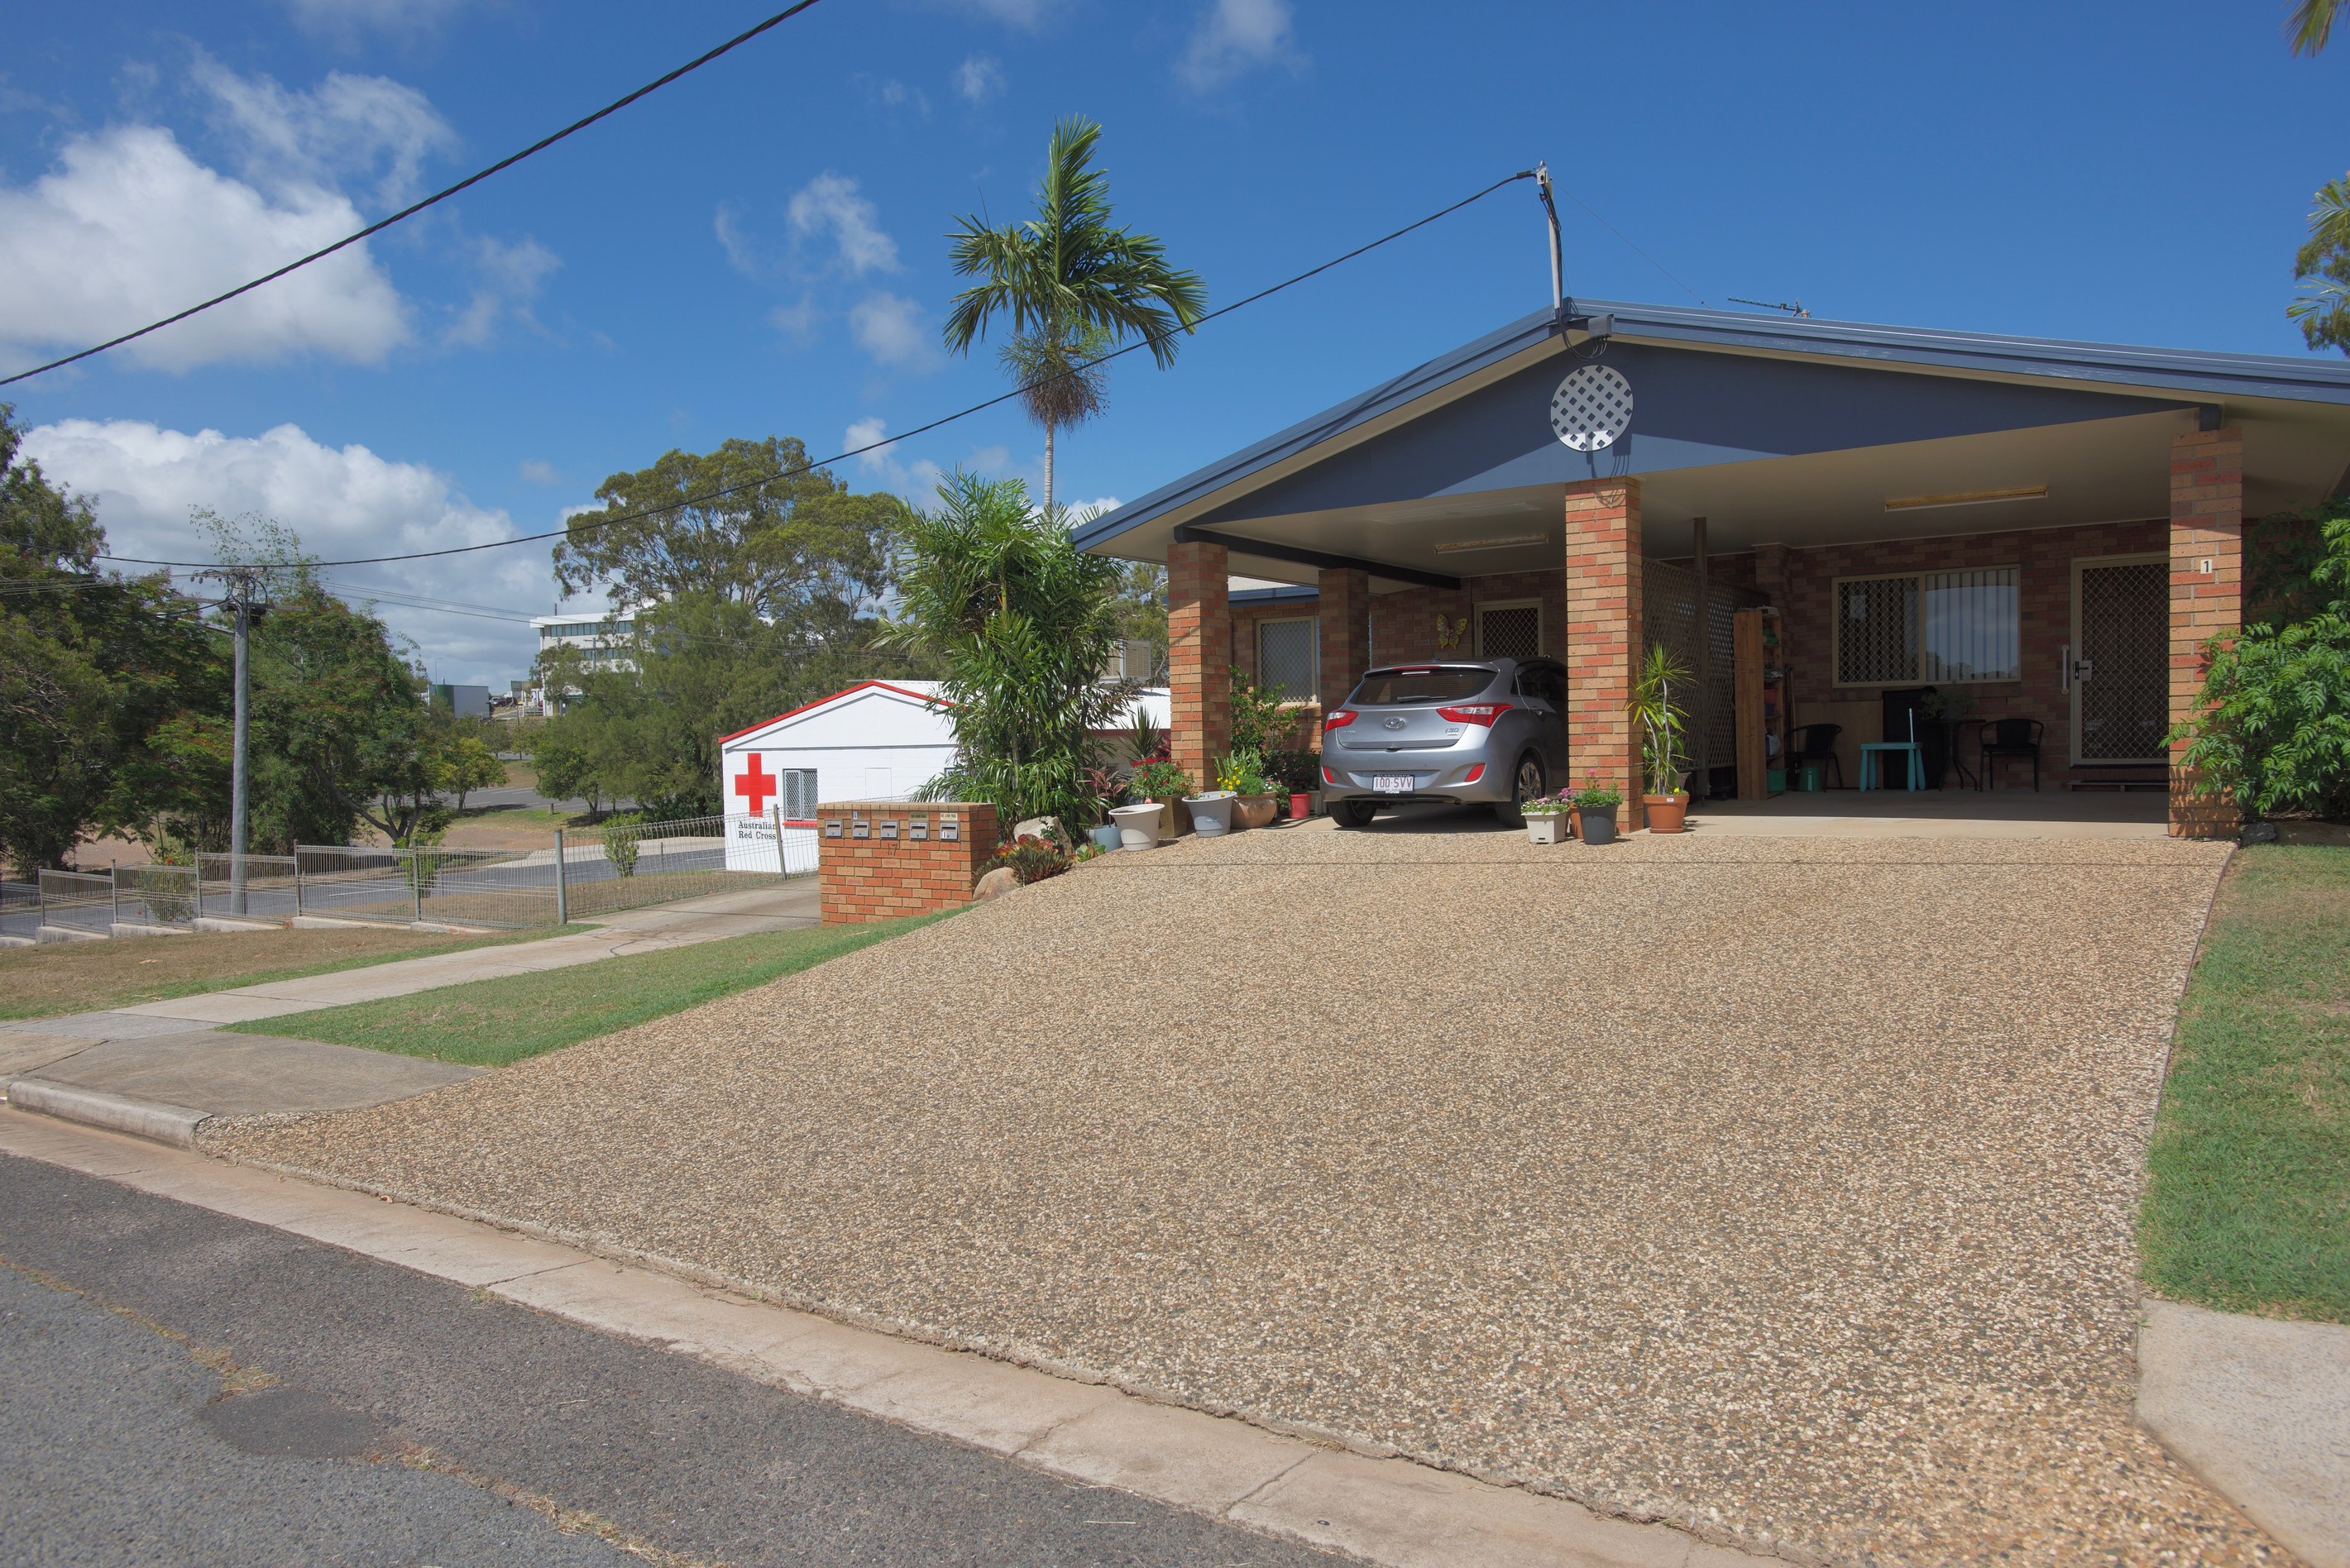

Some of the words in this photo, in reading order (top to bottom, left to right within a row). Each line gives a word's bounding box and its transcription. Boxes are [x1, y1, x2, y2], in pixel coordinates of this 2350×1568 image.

[2204, 561, 2209, 572] 1
[739, 830, 753, 839] Red
[755, 831, 777, 840] Cross
